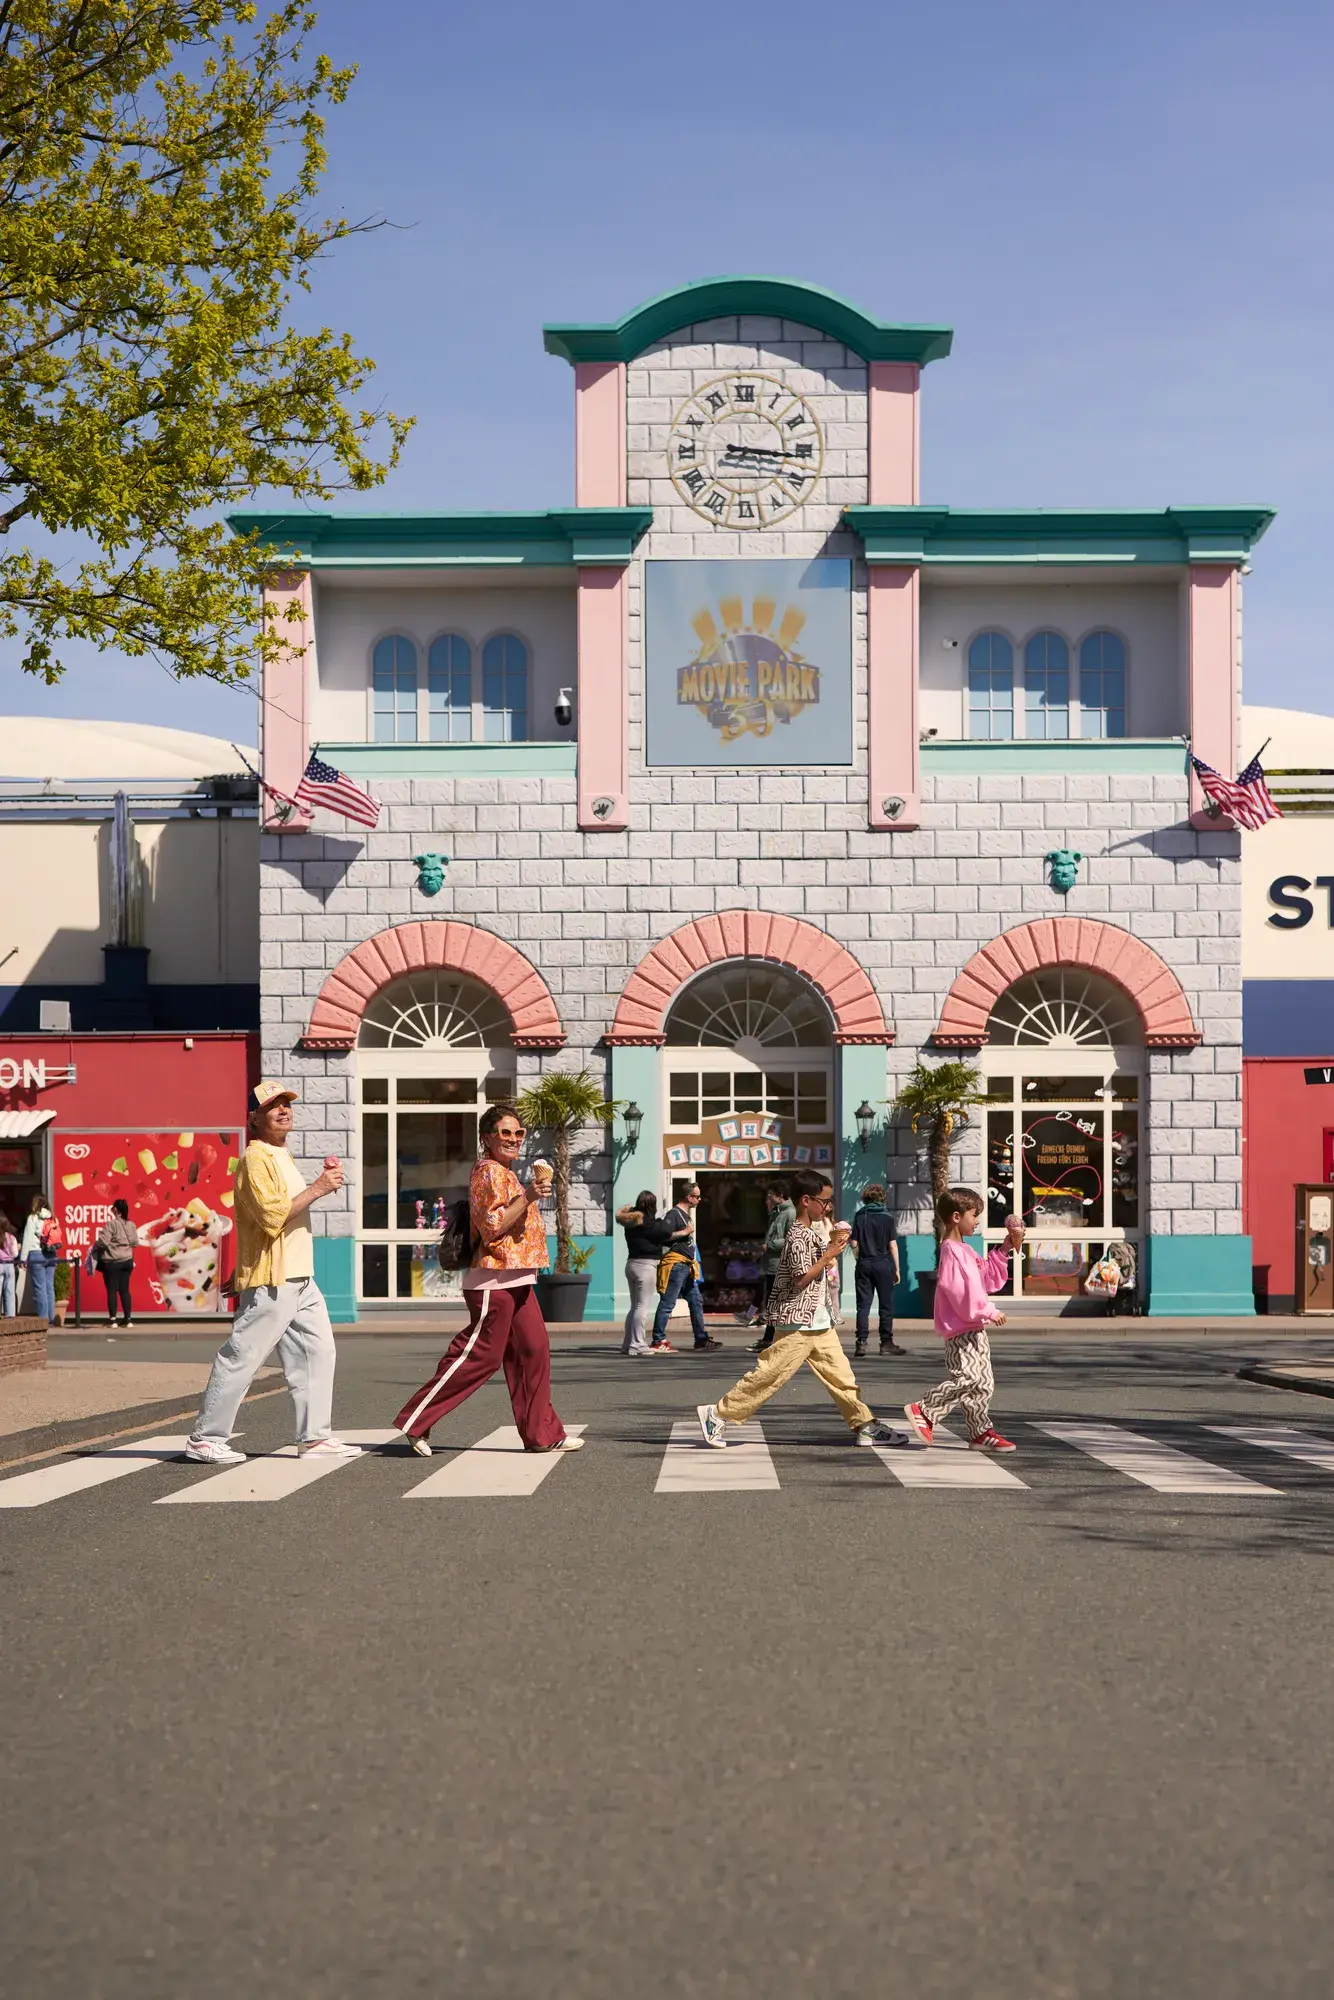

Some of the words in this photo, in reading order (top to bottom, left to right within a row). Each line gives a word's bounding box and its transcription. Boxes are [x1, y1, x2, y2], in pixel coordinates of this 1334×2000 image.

[768, 392, 781, 409] I
[686, 414, 704, 432] X
[681, 661, 749, 702] MOVIE
[757, 661, 817, 701] PARK
[0, 1057, 46, 1089] ON
[721, 1122, 779, 1138] THE
[65, 1227, 90, 1245] WIE
